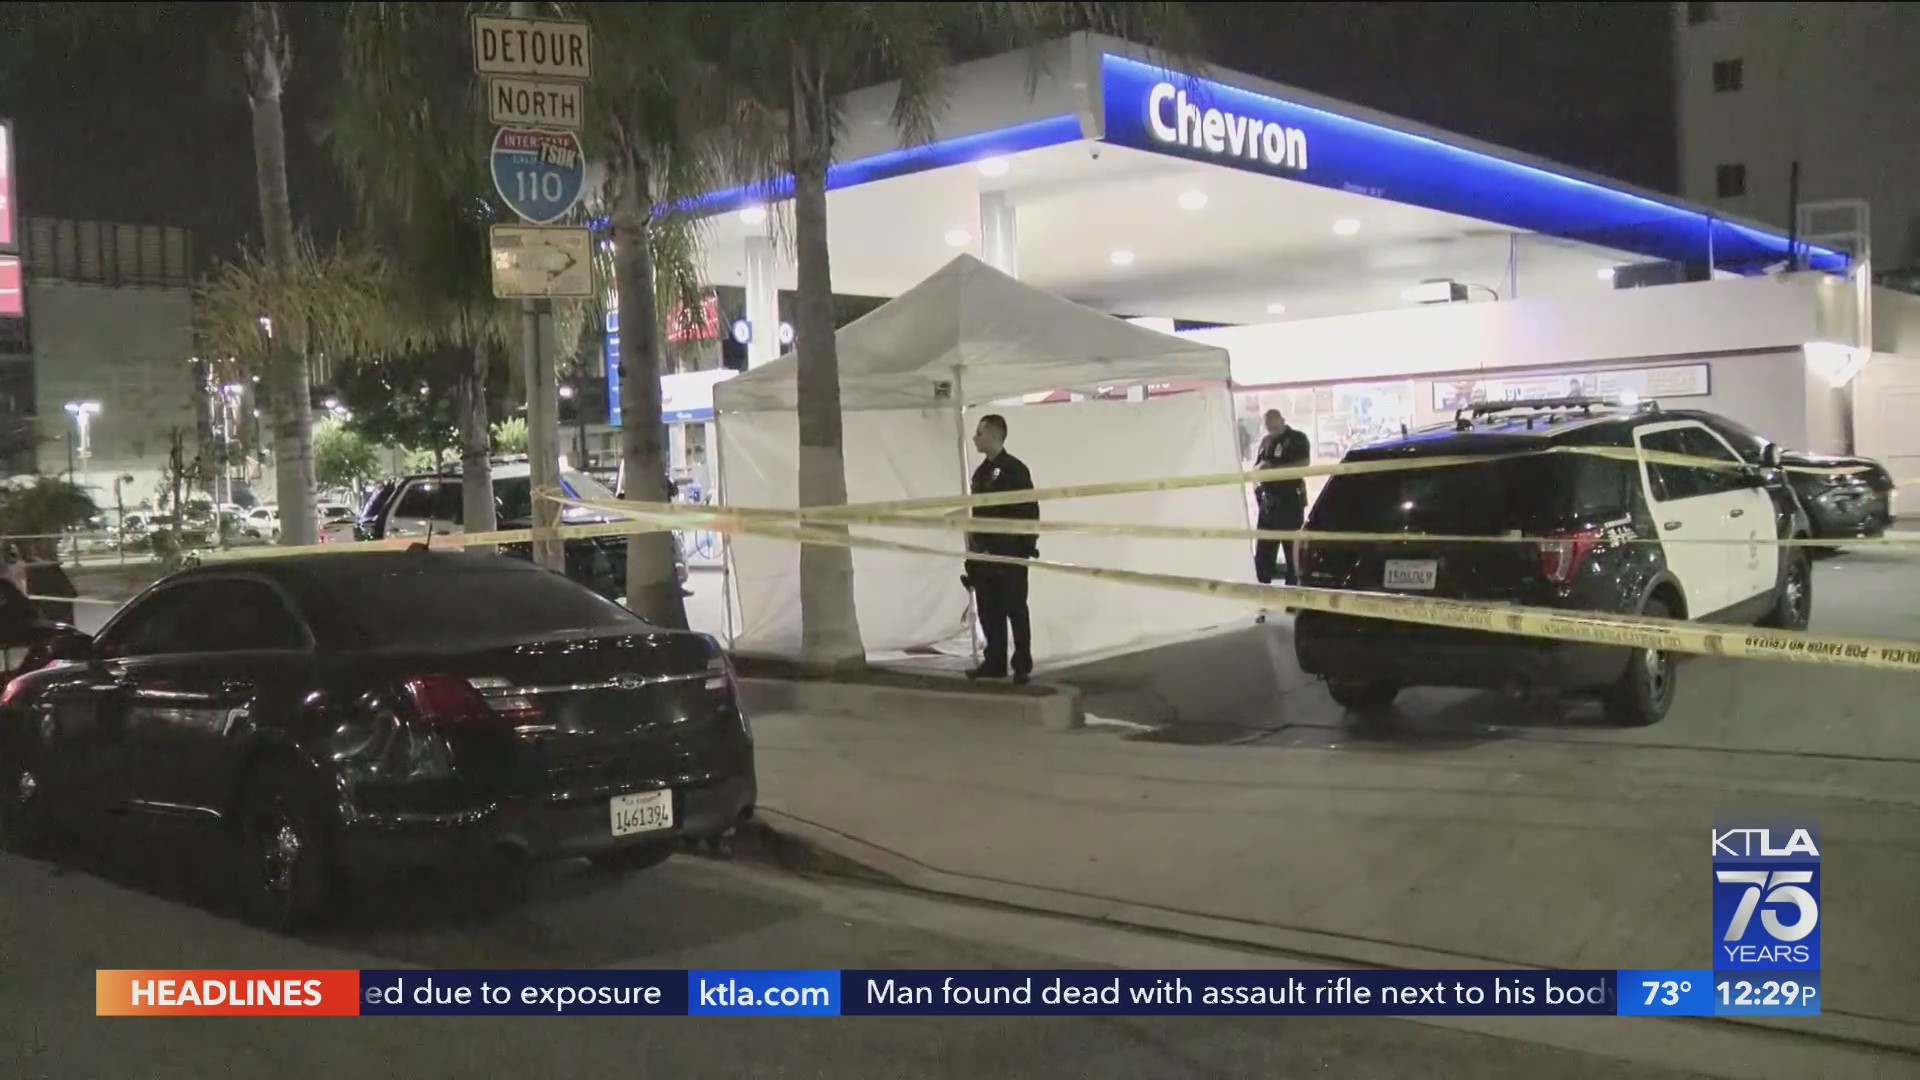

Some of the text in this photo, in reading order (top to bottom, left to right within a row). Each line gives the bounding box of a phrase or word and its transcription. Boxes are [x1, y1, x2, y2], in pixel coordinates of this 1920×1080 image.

[482, 28, 583, 67] DETOUR
[498, 86, 575, 119] NORTH
[1150, 82, 1308, 170] Chevron
[516, 171, 563, 202] 110
[1806, 641, 1842, 655] FAVOR
[1845, 645, 1869, 658] POR
[616, 804, 669, 830] 1461394
